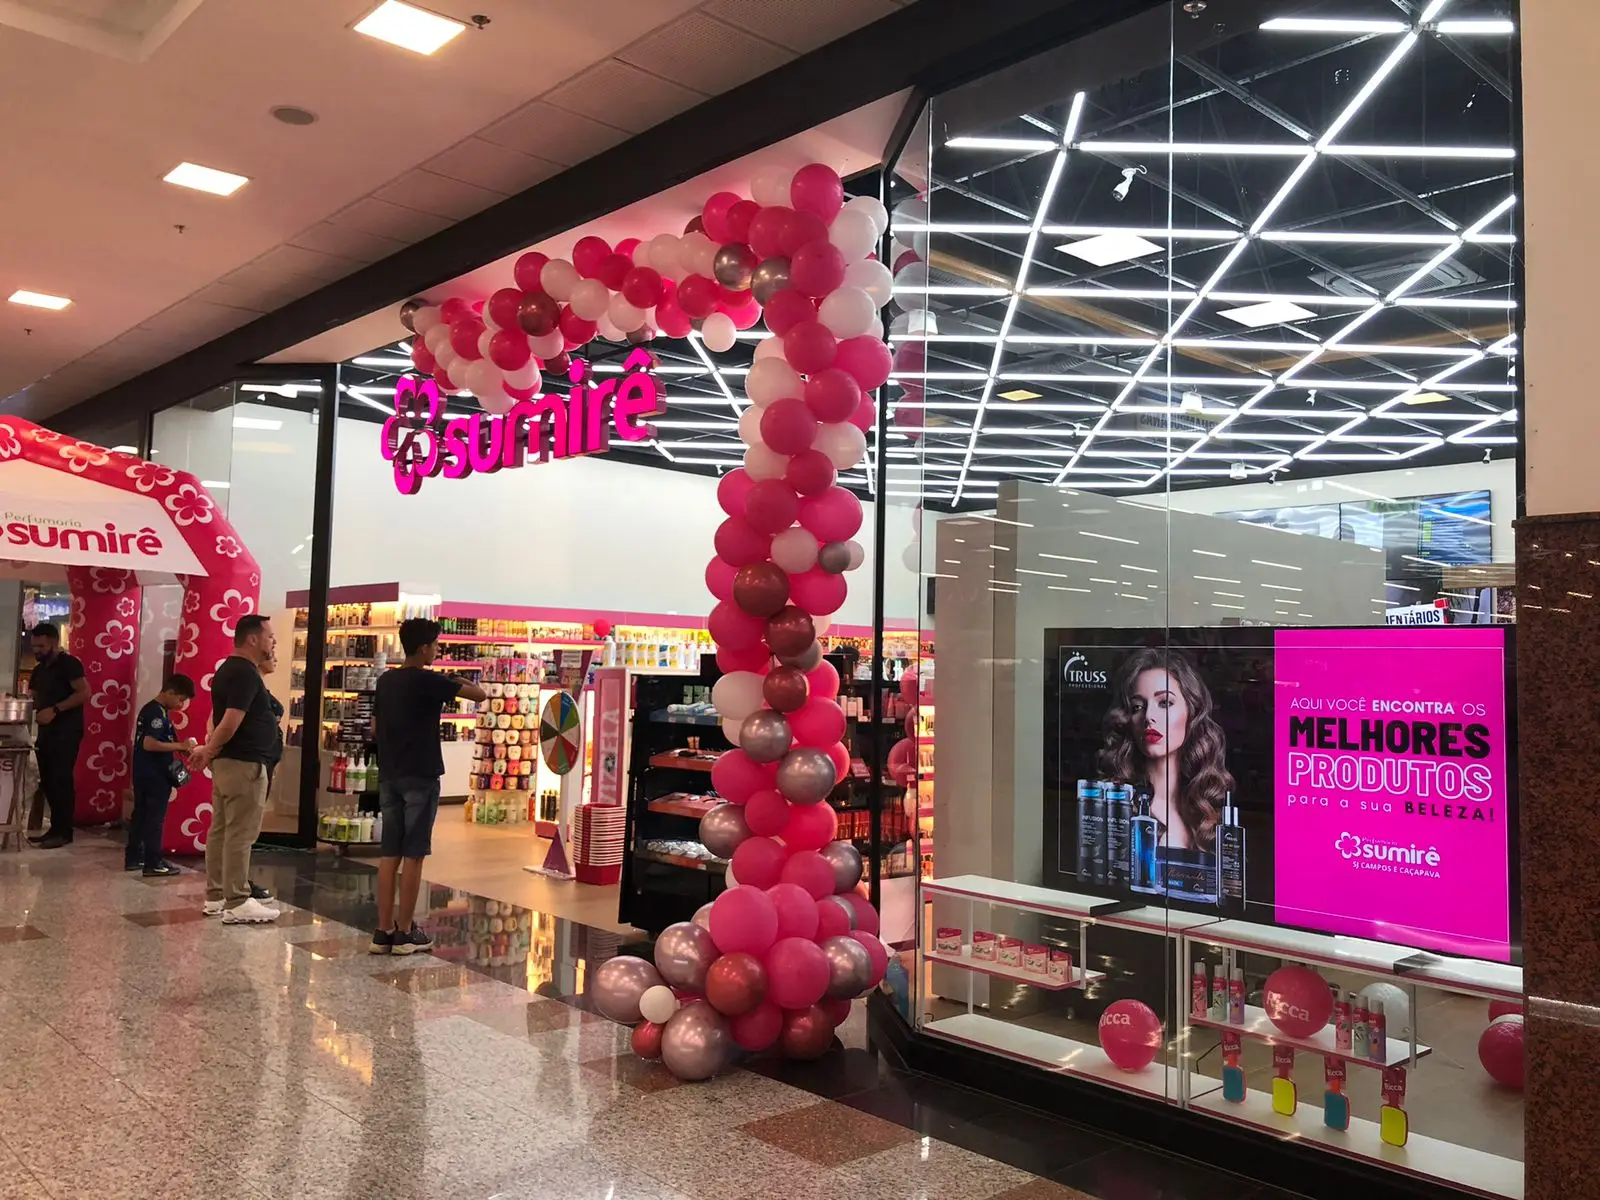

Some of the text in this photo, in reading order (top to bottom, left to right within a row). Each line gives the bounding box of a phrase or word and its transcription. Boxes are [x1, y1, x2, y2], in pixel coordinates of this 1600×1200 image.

[443, 348, 663, 478] sumirê
[4, 511, 82, 528] Perfumaria
[7, 522, 163, 556] sumirê
[1069, 670, 1107, 683] TRUSS
[1290, 697, 1486, 716] AQUI VOCÊ ENCONTRA OS
[1289, 715, 1491, 759] MELHORES
[1288, 752, 1493, 802] PRODUTOS
[1287, 794, 1494, 822] para a sua BELEZA!
[1362, 843, 1441, 866] sumirê
[1352, 861, 1359, 869] SJ
[1361, 861, 1392, 872] CAMPOS
[1399, 867, 1441, 879] CAÇAPAVA
